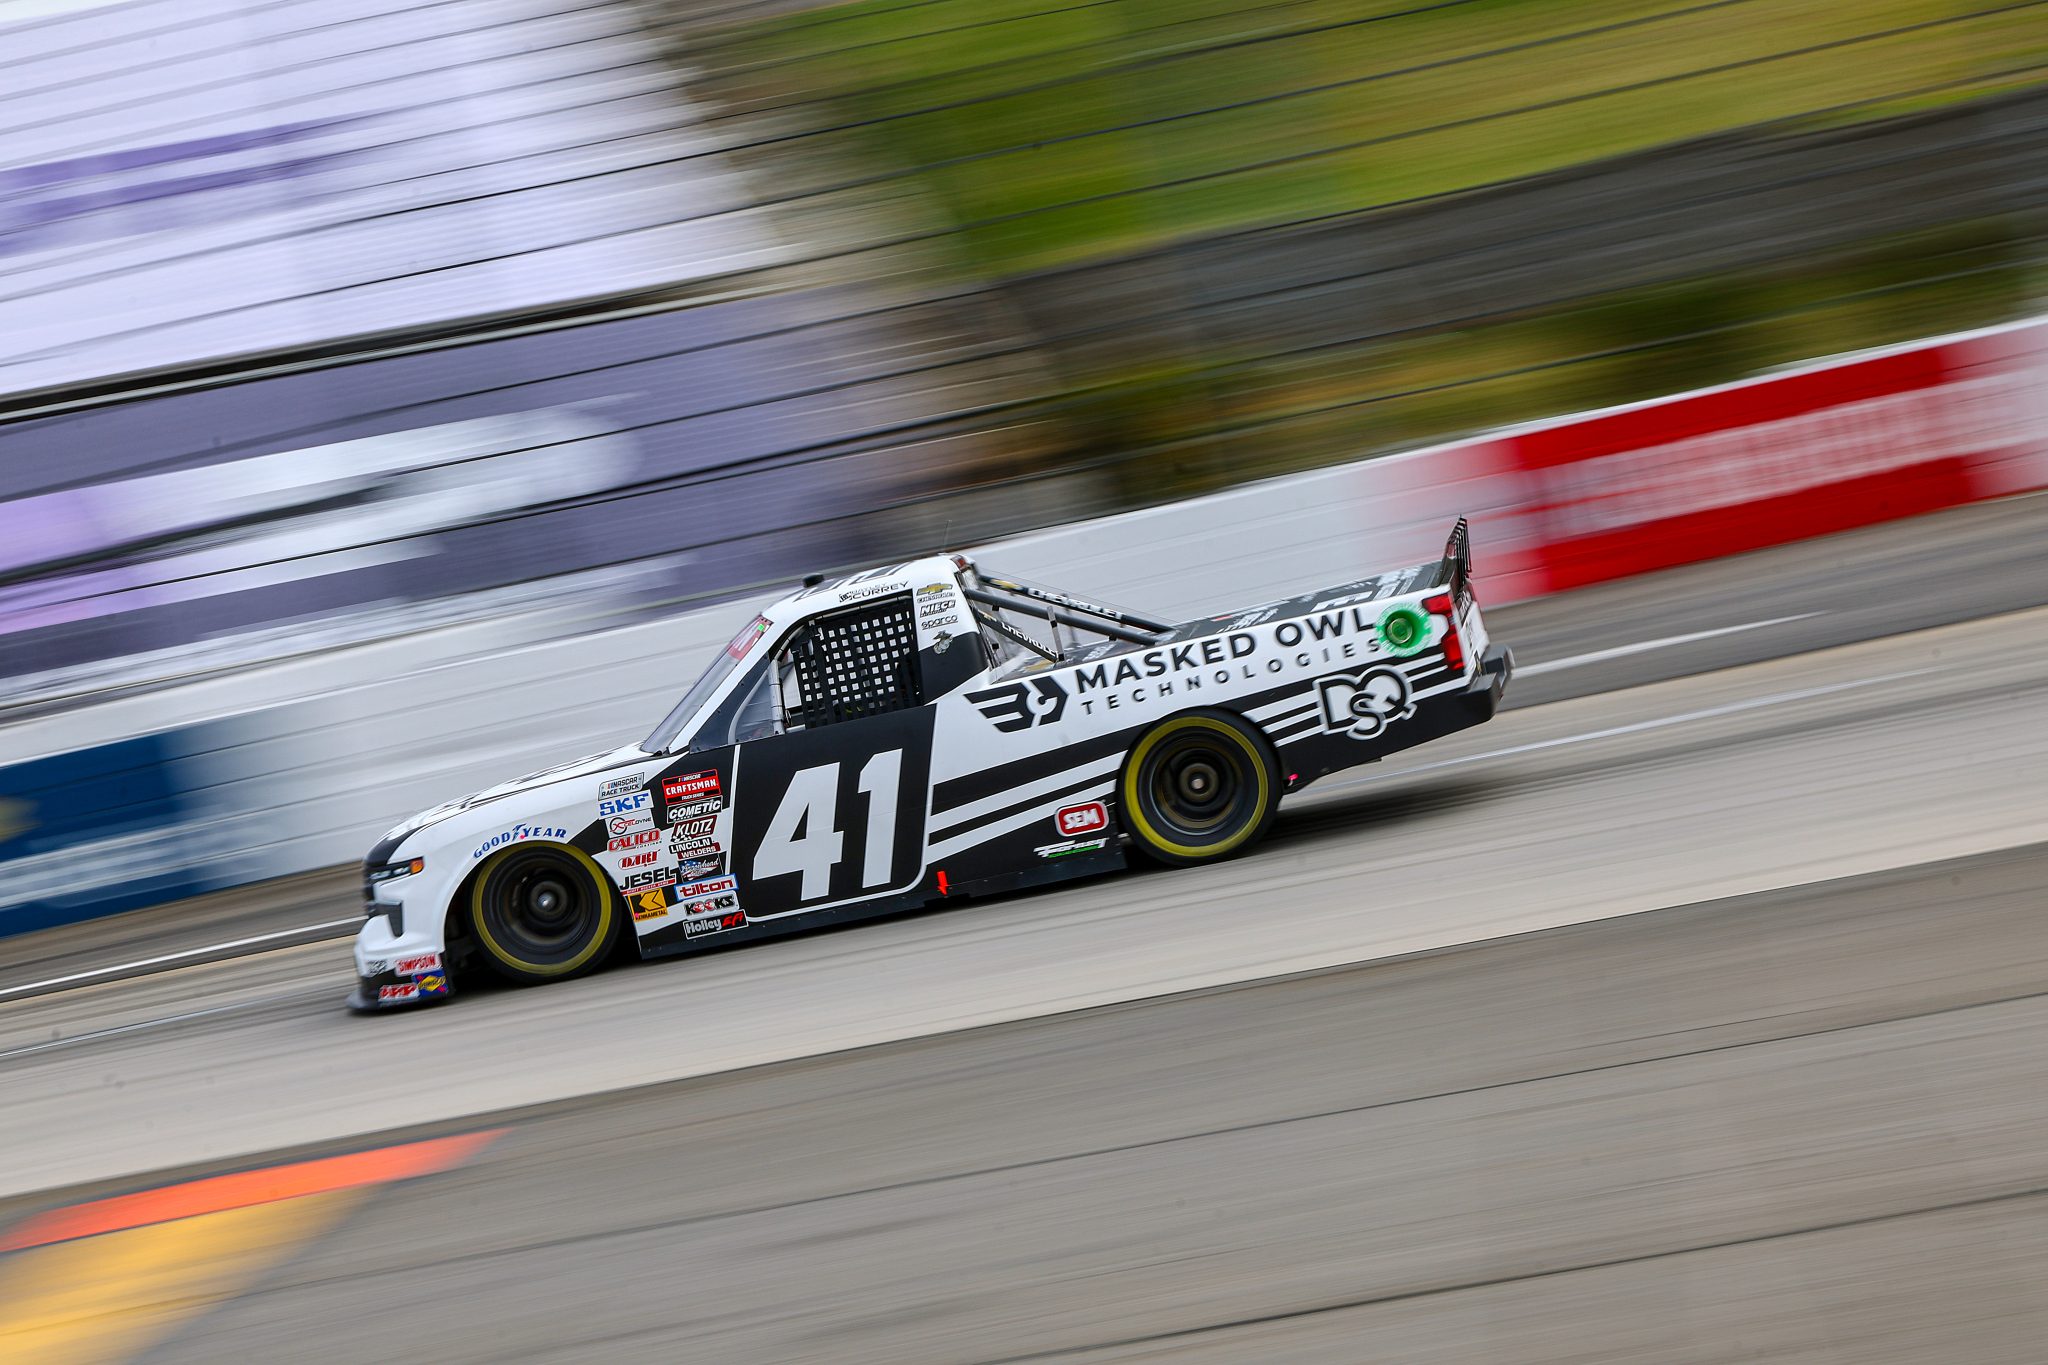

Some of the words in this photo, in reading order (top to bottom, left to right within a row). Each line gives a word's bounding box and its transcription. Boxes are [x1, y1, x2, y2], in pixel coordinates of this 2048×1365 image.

[853, 581, 910, 600] CURREY
[1076, 633, 1257, 694] MASKED
[1275, 608, 1376, 648] OWL
[1082, 638, 1380, 715] TECHNOLOGIES
[601, 788, 618, 797] RACE
[620, 784, 639, 793] TRUCK
[610, 777, 638, 789] NASCAR
[665, 779, 716, 796] CRAFTSMAN
[600, 793, 649, 816] SKF
[669, 799, 721, 820] COMETIC
[675, 818, 714, 837] KLOTZ
[753, 748, 903, 901] 41
[1063, 808, 1101, 830] SEM
[608, 829, 660, 851] CALICO
[670, 839, 711, 853] LINCOLN
[681, 846, 717, 858] WELDERS
[619, 867, 676, 890] JESEL
[680, 880, 734, 897] tilton
[684, 894, 735, 915] KOOKS
[685, 919, 722, 934] Holley
